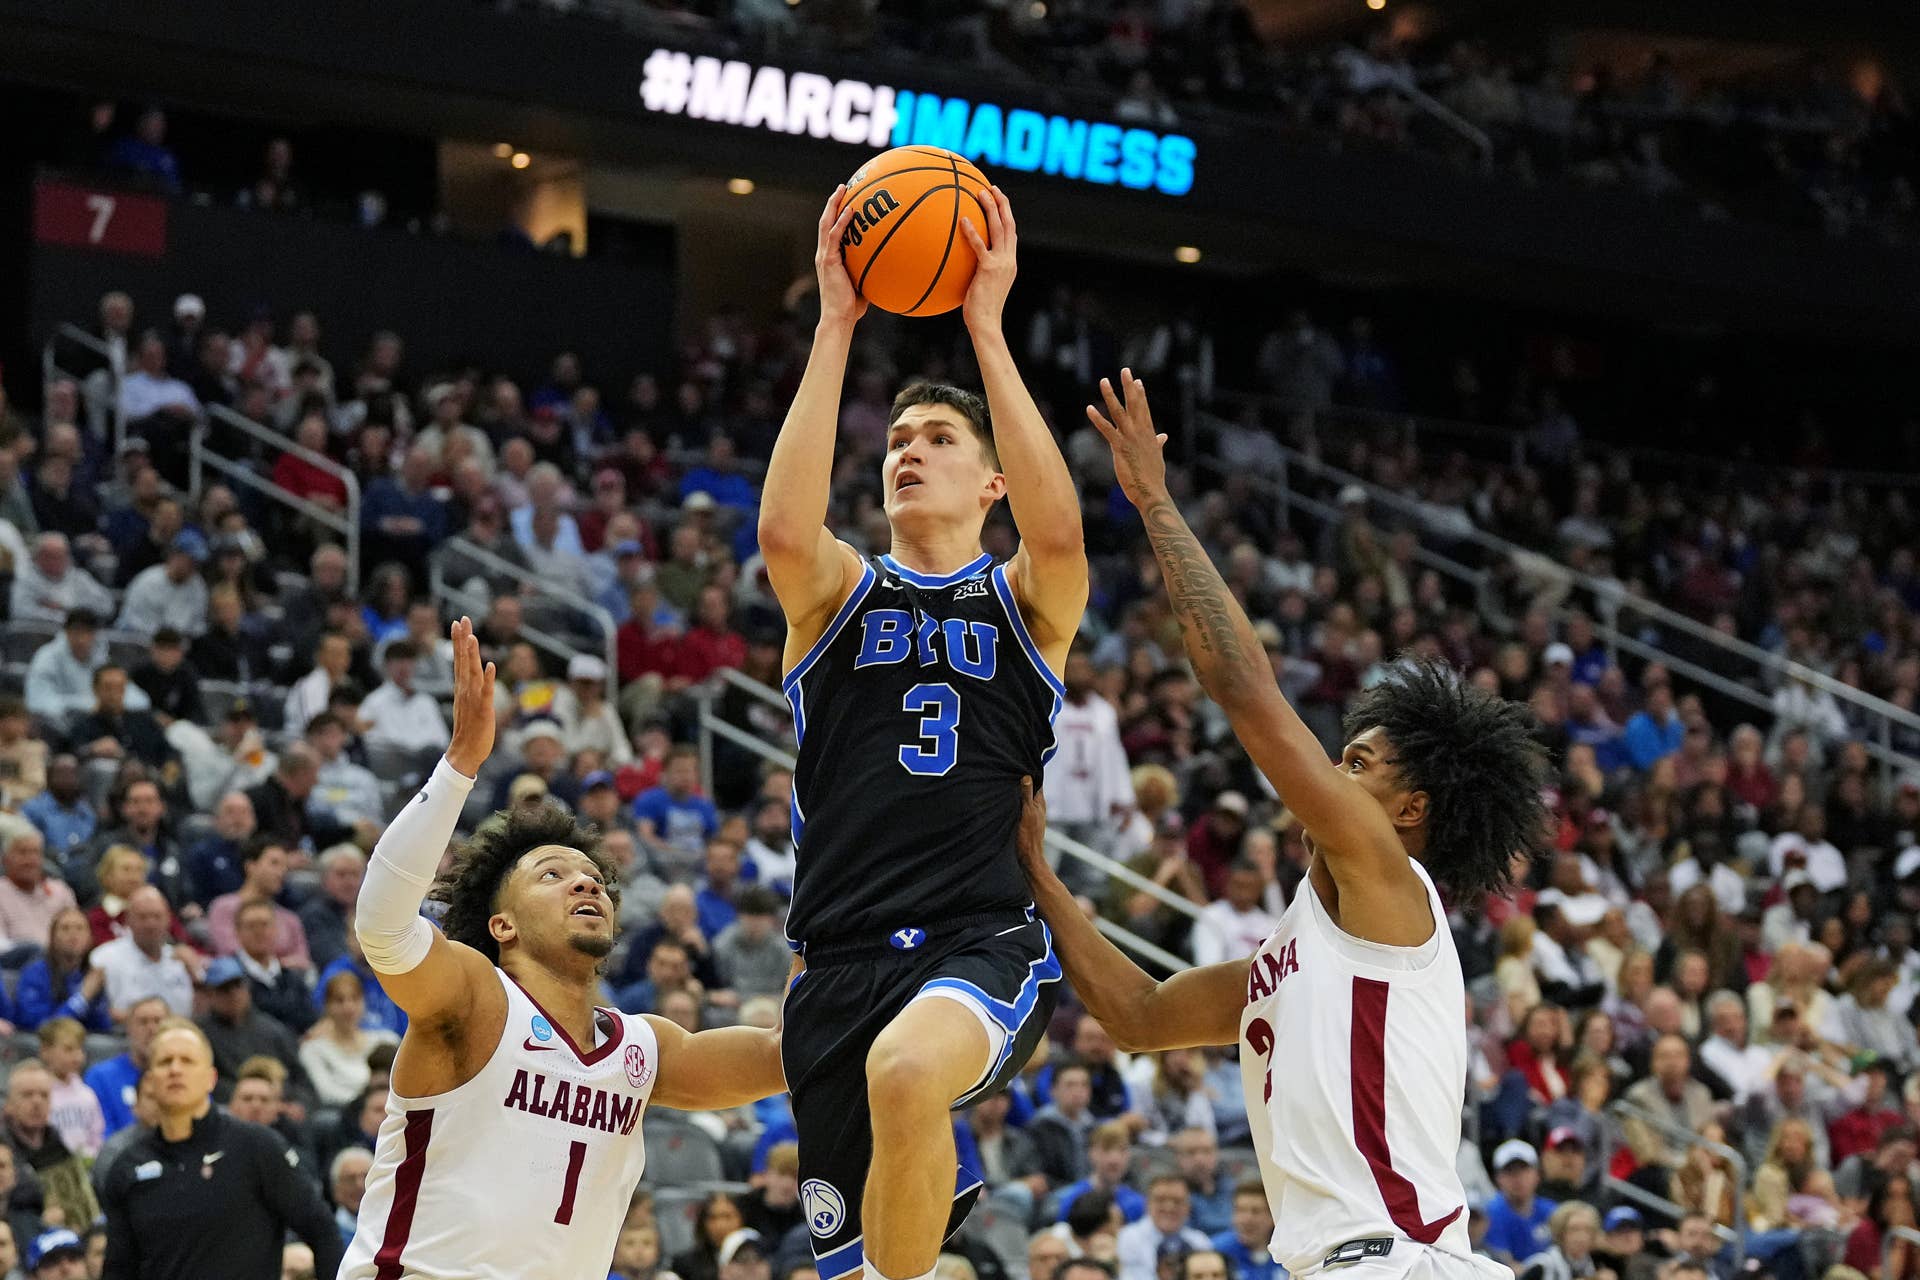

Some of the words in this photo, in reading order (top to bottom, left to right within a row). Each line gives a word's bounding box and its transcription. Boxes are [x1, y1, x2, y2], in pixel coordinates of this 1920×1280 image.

[86, 194, 116, 244] 7
[854, 608, 999, 681] BYU
[898, 682, 961, 776] 3
[895, 928, 919, 948] Y
[625, 1045, 645, 1077] SEC
[504, 1069, 643, 1136] ALABAMA
[554, 1140, 588, 1226] 1
[815, 1212, 830, 1228] Y
[1368, 1244, 1381, 1252] 44
